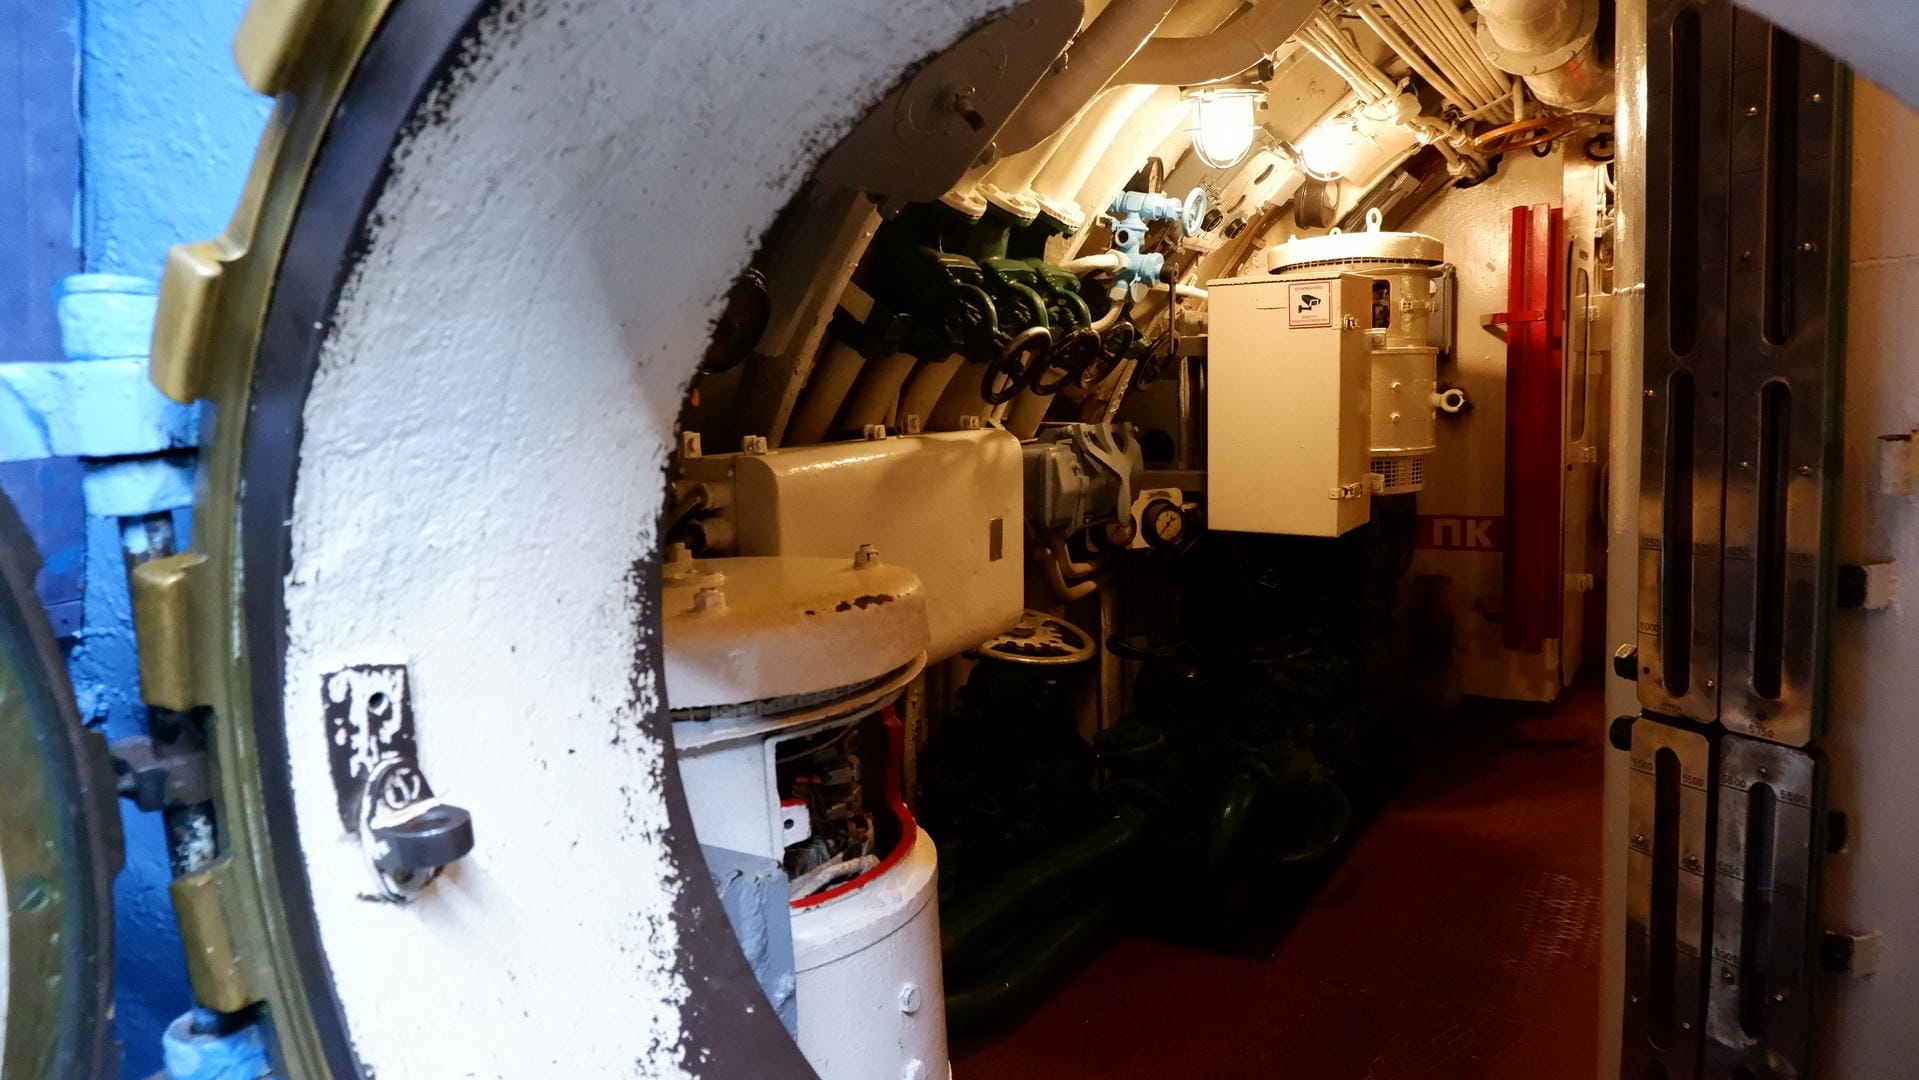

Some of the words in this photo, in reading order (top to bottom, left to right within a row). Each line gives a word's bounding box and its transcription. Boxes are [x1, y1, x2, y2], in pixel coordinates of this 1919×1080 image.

[1433, 518, 1493, 548] ПК
[1748, 723, 1774, 739] 5750
[1682, 774, 1704, 788] 5500
